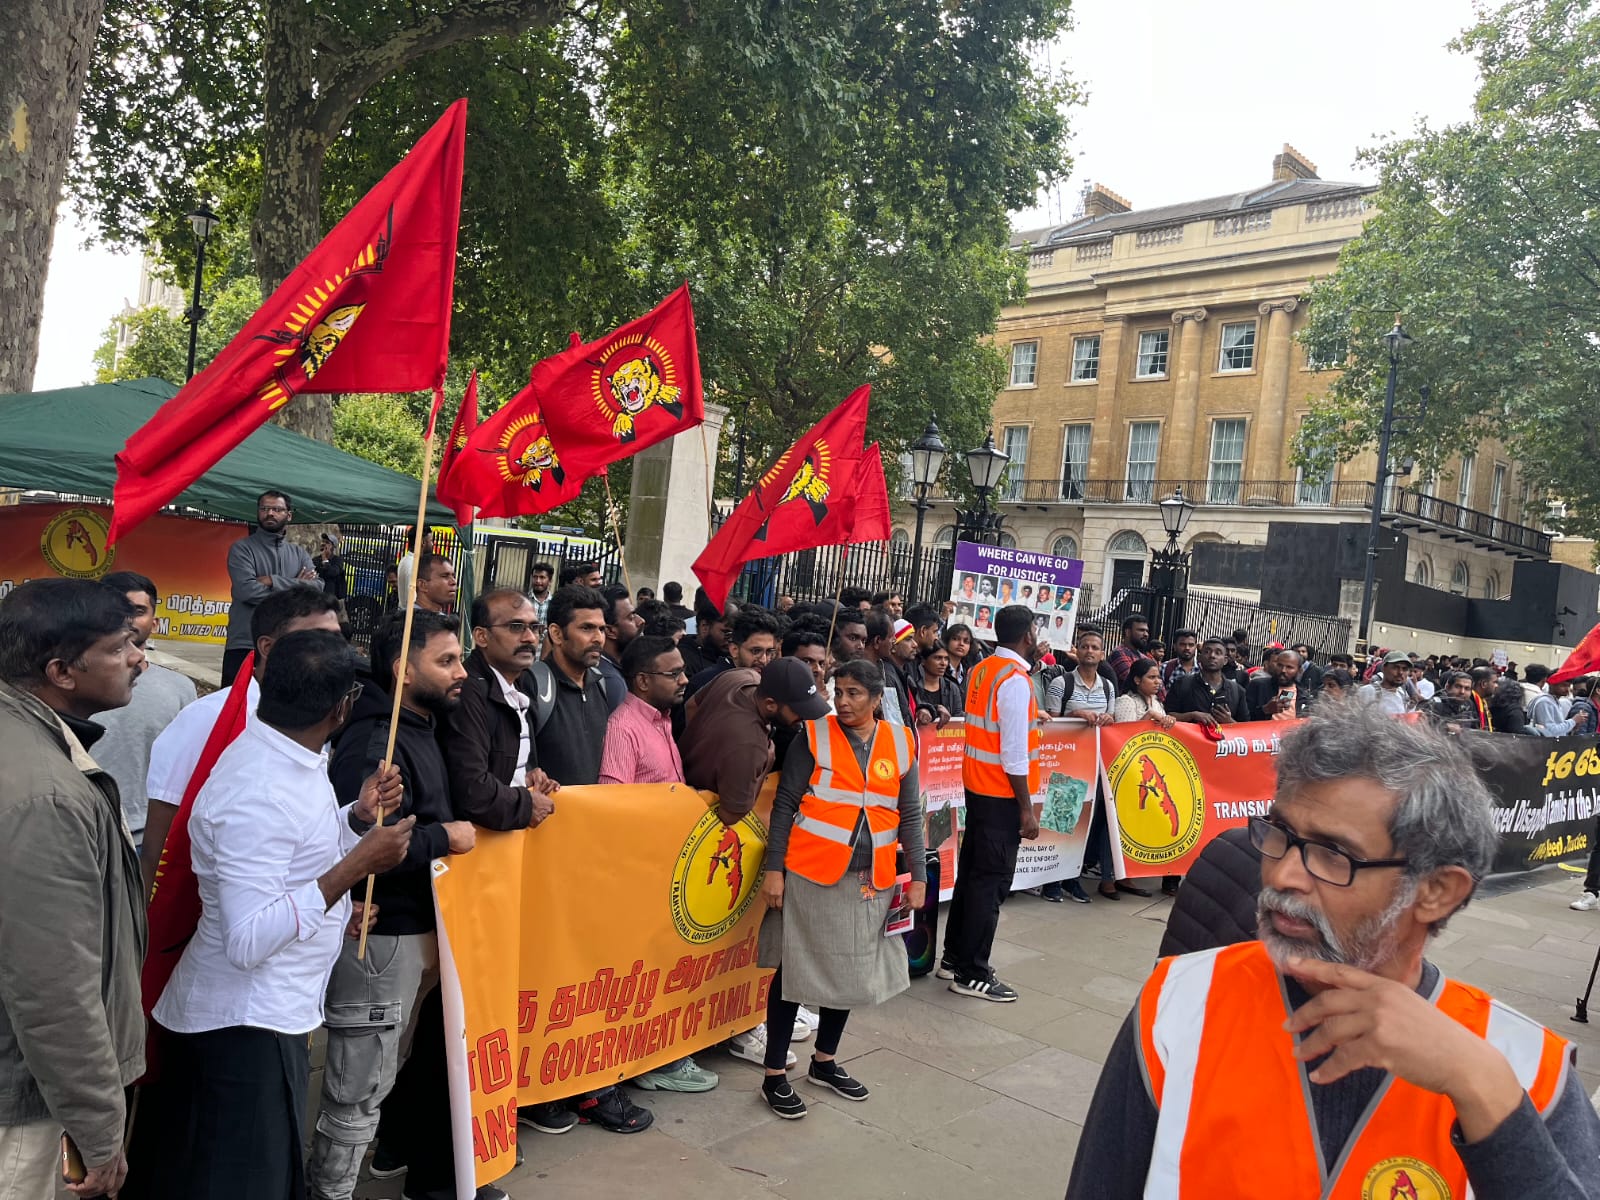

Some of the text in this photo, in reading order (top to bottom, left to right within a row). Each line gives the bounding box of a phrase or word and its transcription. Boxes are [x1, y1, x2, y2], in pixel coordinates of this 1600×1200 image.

[978, 546, 1068, 570] WHERE CAN WE GO
[987, 564, 1056, 584] FOR JUSTICE ?
[157, 617, 170, 635] M
[180, 624, 211, 636] UNITED
[213, 625, 228, 637] KIN
[1214, 736, 1249, 759] நாடு
[1213, 800, 1276, 819] TRANSNA
[1567, 789, 1575, 821] in
[1576, 788, 1592, 820] the
[1134, 849, 1177, 860] GOVERNMENT
[1178, 845, 1186, 854] OF
[1186, 829, 1199, 847] TAMIL
[1195, 798, 1203, 826] EELAM
[672, 881, 692, 938] TRANSNATIONAL
[691, 924, 728, 941] GOVERNMENT
[544, 959, 660, 1037] தமிழீழ
[540, 1006, 682, 1086] GOVERNMENT
[682, 997, 706, 1041] OF
[708, 981, 752, 1030] TAMIL
